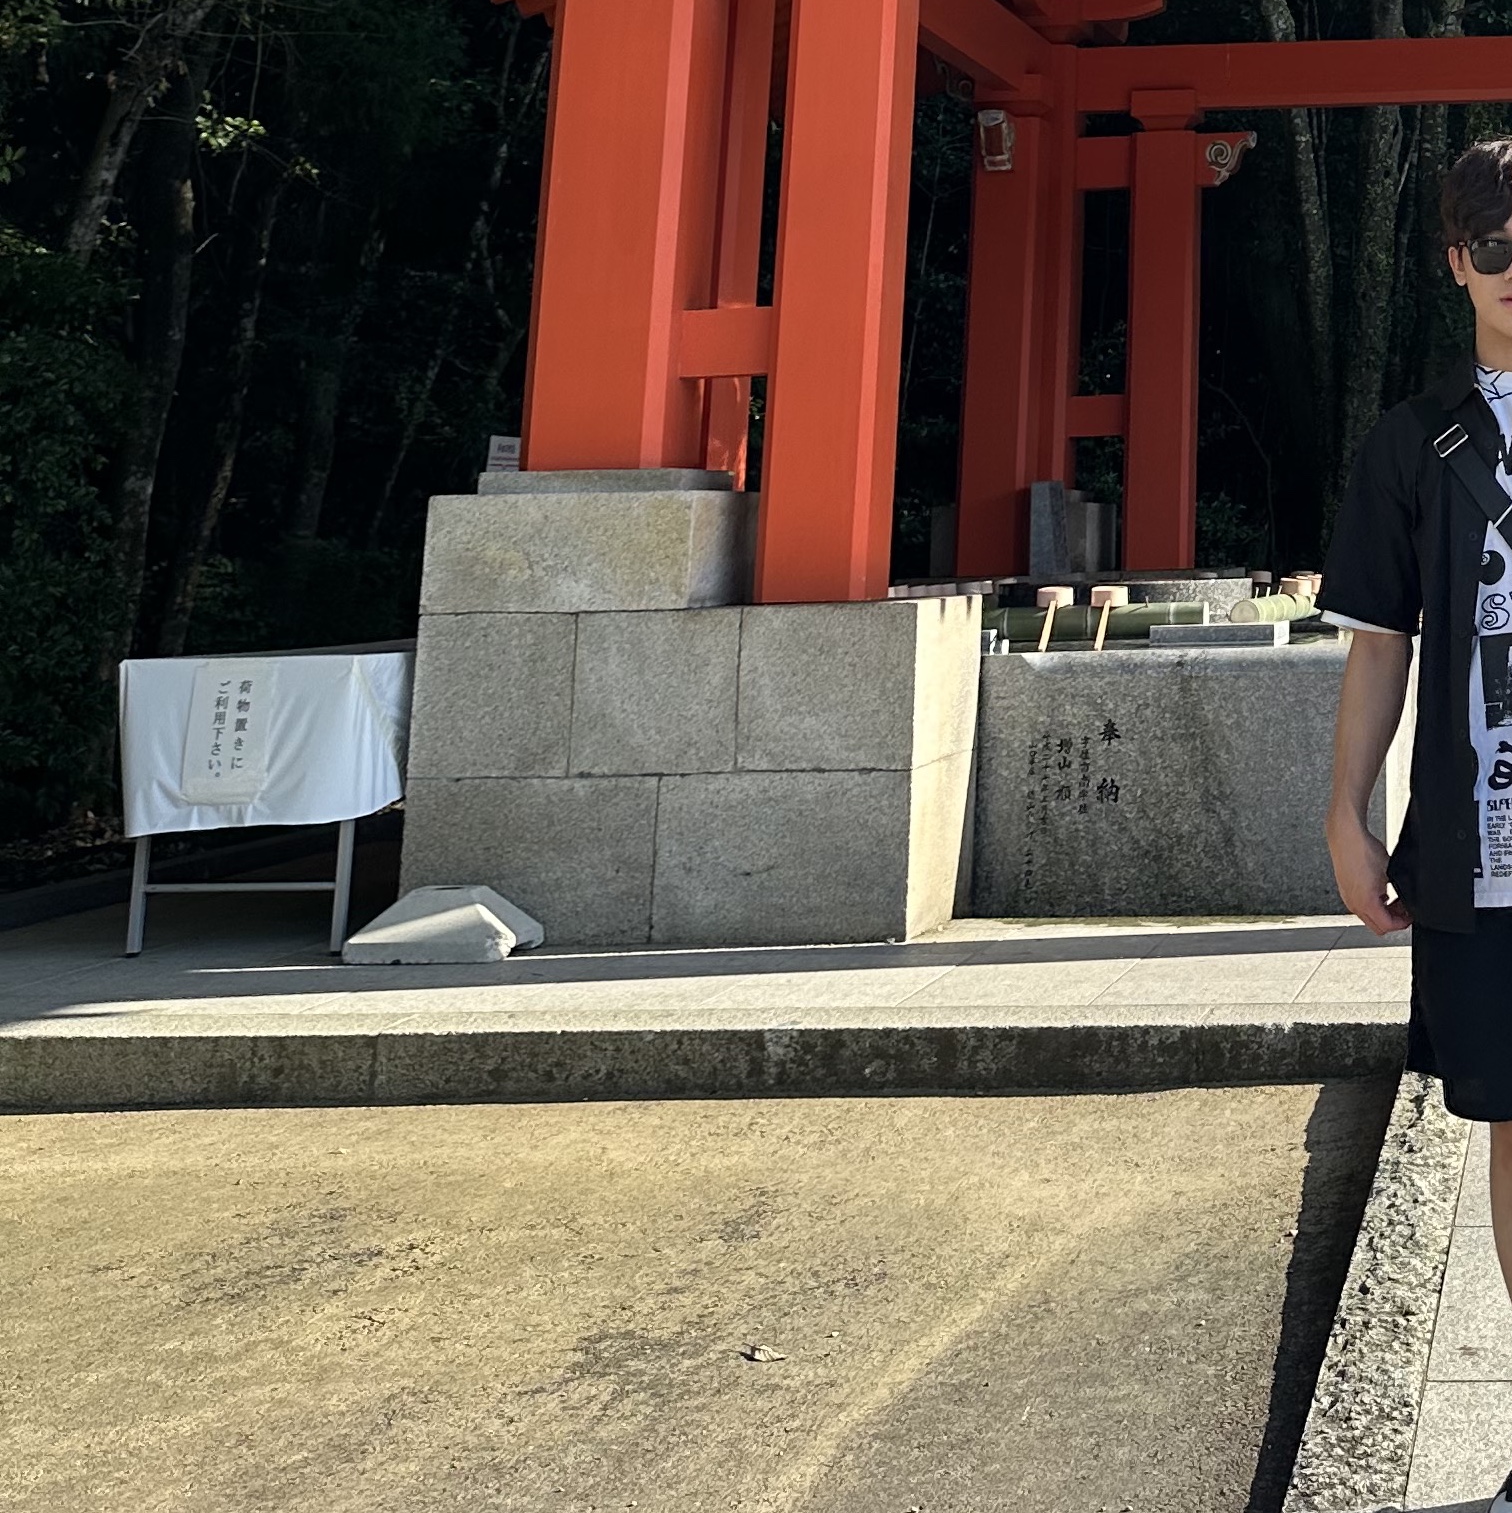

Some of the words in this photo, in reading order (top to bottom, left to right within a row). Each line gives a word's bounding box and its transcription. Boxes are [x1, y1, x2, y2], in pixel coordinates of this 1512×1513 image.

[230, 679, 253, 770] 荷物置きに
[1096, 718, 1121, 804] 奉納
